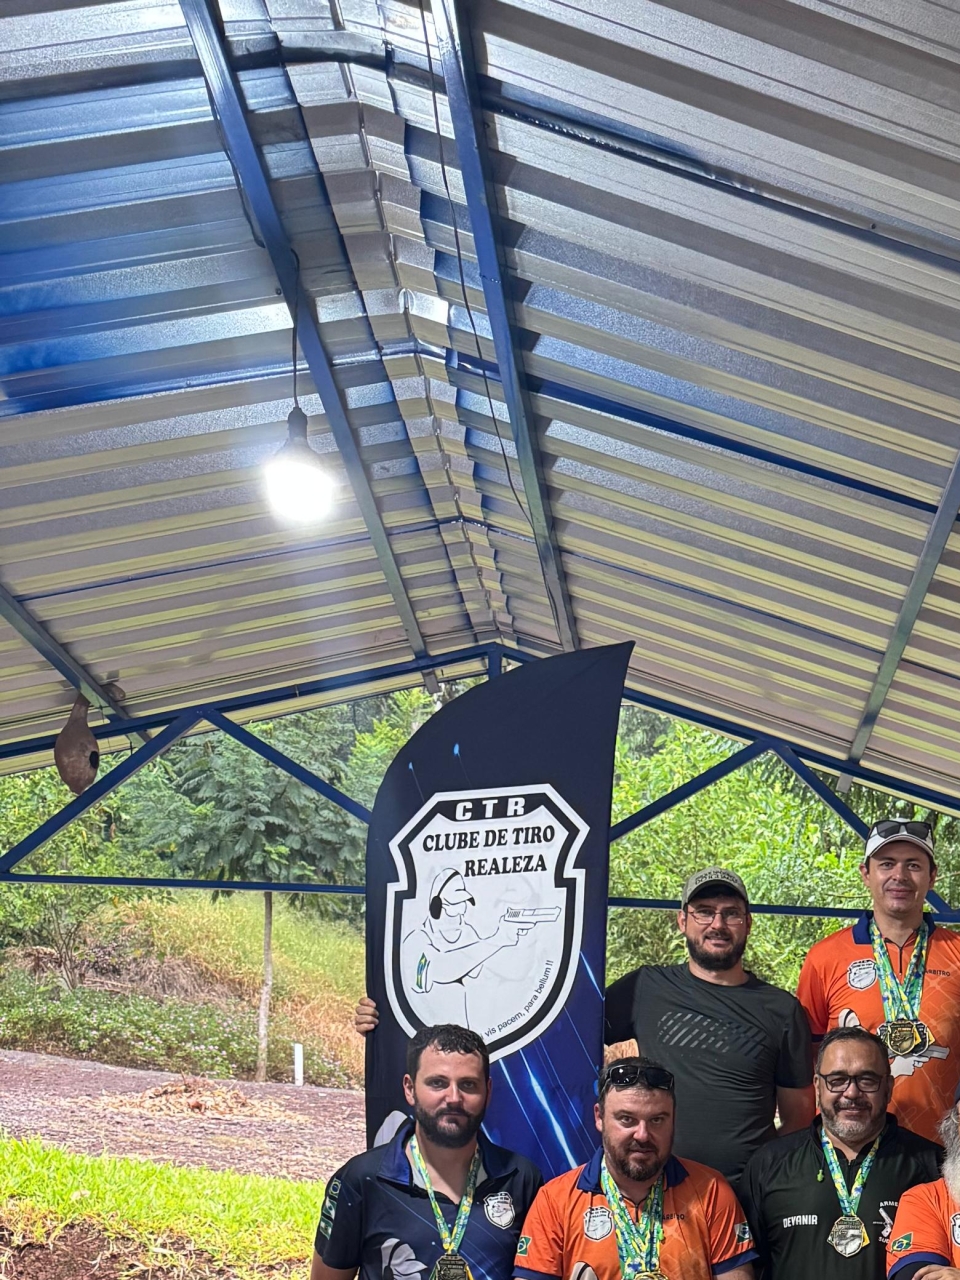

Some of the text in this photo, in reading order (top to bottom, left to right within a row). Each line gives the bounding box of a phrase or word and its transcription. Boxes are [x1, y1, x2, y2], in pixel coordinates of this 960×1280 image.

[455, 797, 526, 820] CTR
[422, 825, 555, 852] CLUBE DE TIRO
[464, 854, 547, 877] REALEZA
[484, 1027, 497, 1037] vis
[497, 1011, 526, 1032] pacem,
[523, 994, 539, 1013] para
[534, 967, 551, 994] bellum
[783, 1214, 818, 1228] DEVANIR
